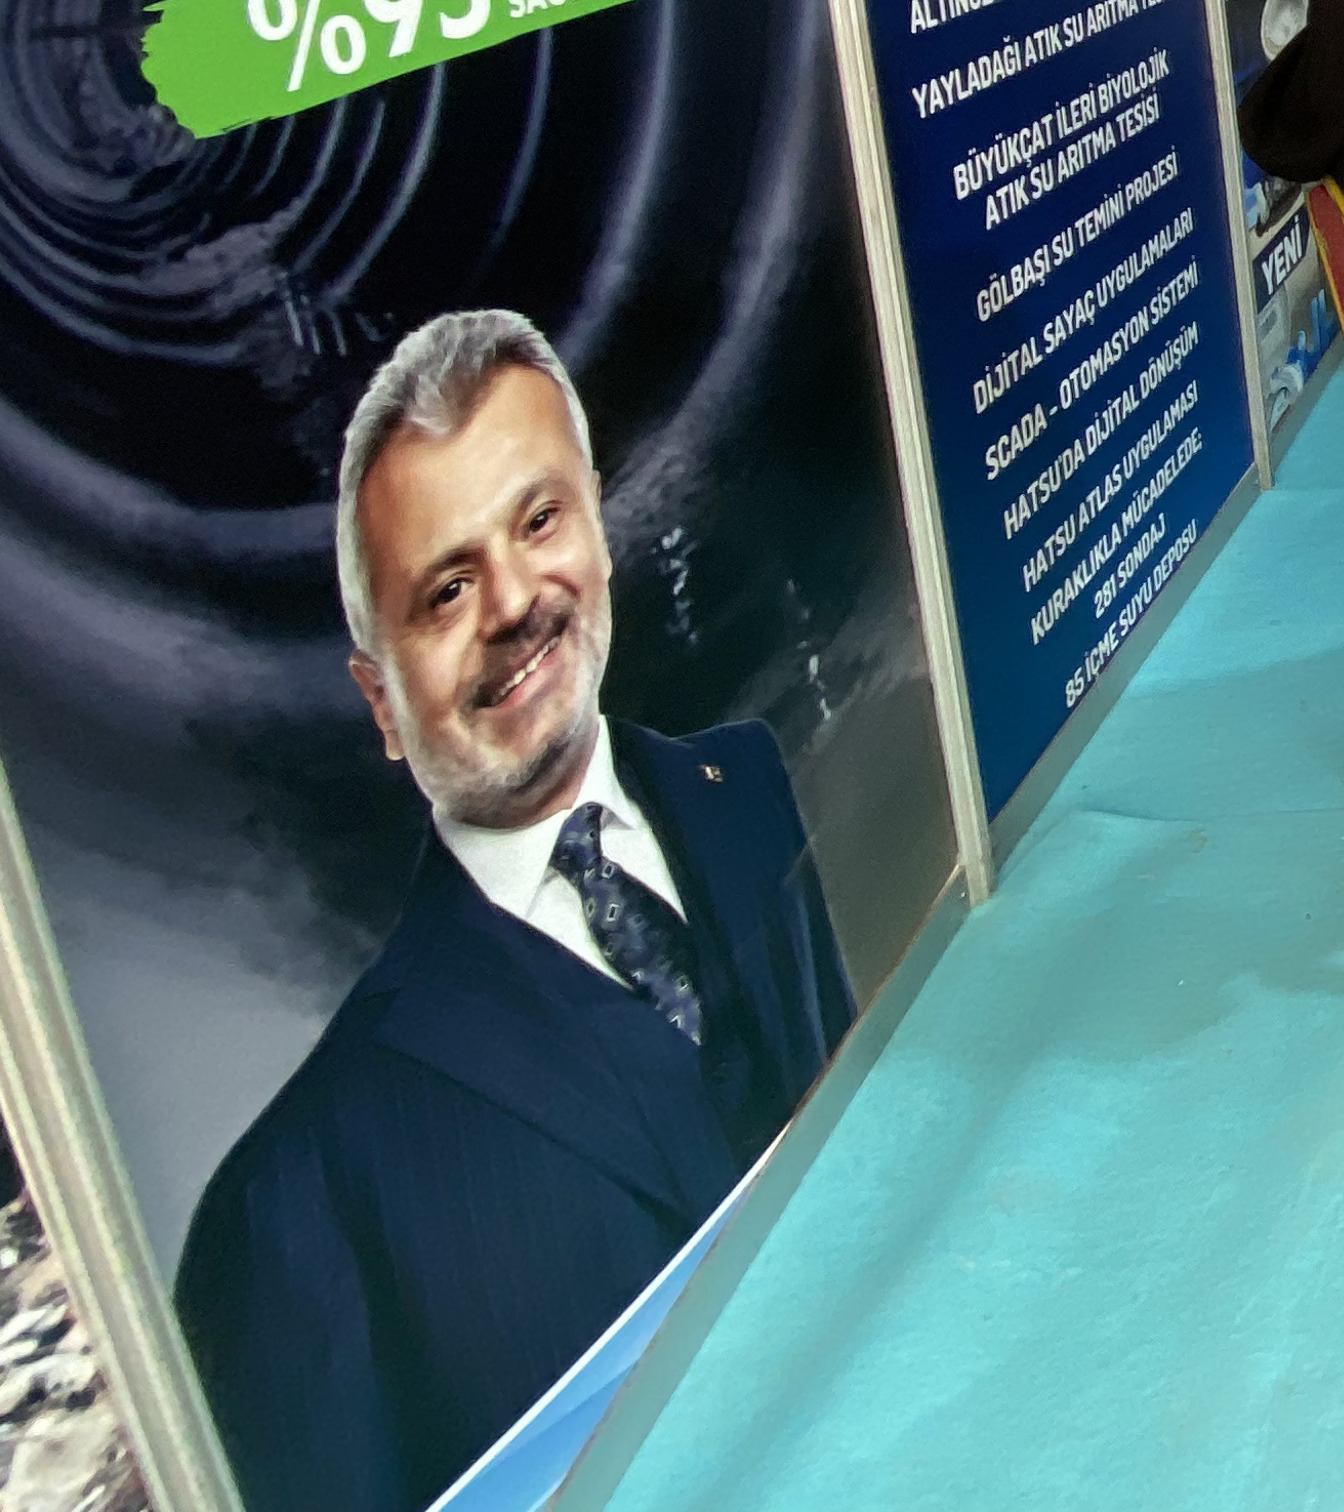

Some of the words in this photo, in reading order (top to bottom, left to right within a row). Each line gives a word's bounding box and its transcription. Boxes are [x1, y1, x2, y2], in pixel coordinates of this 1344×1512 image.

[912, 35, 1022, 119] YAYLADAĞI
[1025, 23, 1063, 67] ATIK
[1063, 12, 1084, 47] SU
[953, 114, 1053, 200] BÜYÜKÇAT
[1056, 82, 1097, 139] İLERİ
[1097, 47, 1170, 114] BİYOLOJİK
[976, 245, 1050, 322] GÖLBAŞI
[1052, 227, 1074, 266] SU
[1075, 183, 1125, 247] TEMİNİ
[1125, 145, 1178, 211] PROJESİ
[985, 176, 1030, 230] ATIK
[1030, 159, 1055, 200] SU
[1057, 122, 1116, 183] ARITMA
[1115, 86, 1160, 142] TESİSİ
[973, 337, 1043, 414] DİJİTAL
[1043, 290, 1095, 353] SAYAÇ
[1096, 207, 1194, 308] UYGULAMALARI
[1260, 216, 1303, 296] YENİ
[985, 403, 1048, 480] SCADA
[1059, 306, 1149, 410] OTOMASYON
[1150, 255, 1199, 325] SİSTEMİ
[1003, 439, 1086, 540] HATSU'DA
[1085, 384, 1140, 456] DİJİTAL
[1139, 321, 1199, 400] DÖNÜŞÜM
[1022, 514, 1076, 593] HATSU
[1078, 464, 1122, 532] ATLAS
[1122, 379, 1199, 479] UYGULAMASI
[1093, 573, 1117, 619] 281
[1116, 512, 1166, 588] SONDAJ
[1030, 523, 1121, 645] KURAKLIKLA
[1065, 667, 1085, 708] 85
[1083, 621, 1119, 683] İÇME
[1118, 576, 1152, 637] SUYU
[1153, 518, 1198, 591] DEPOSU
